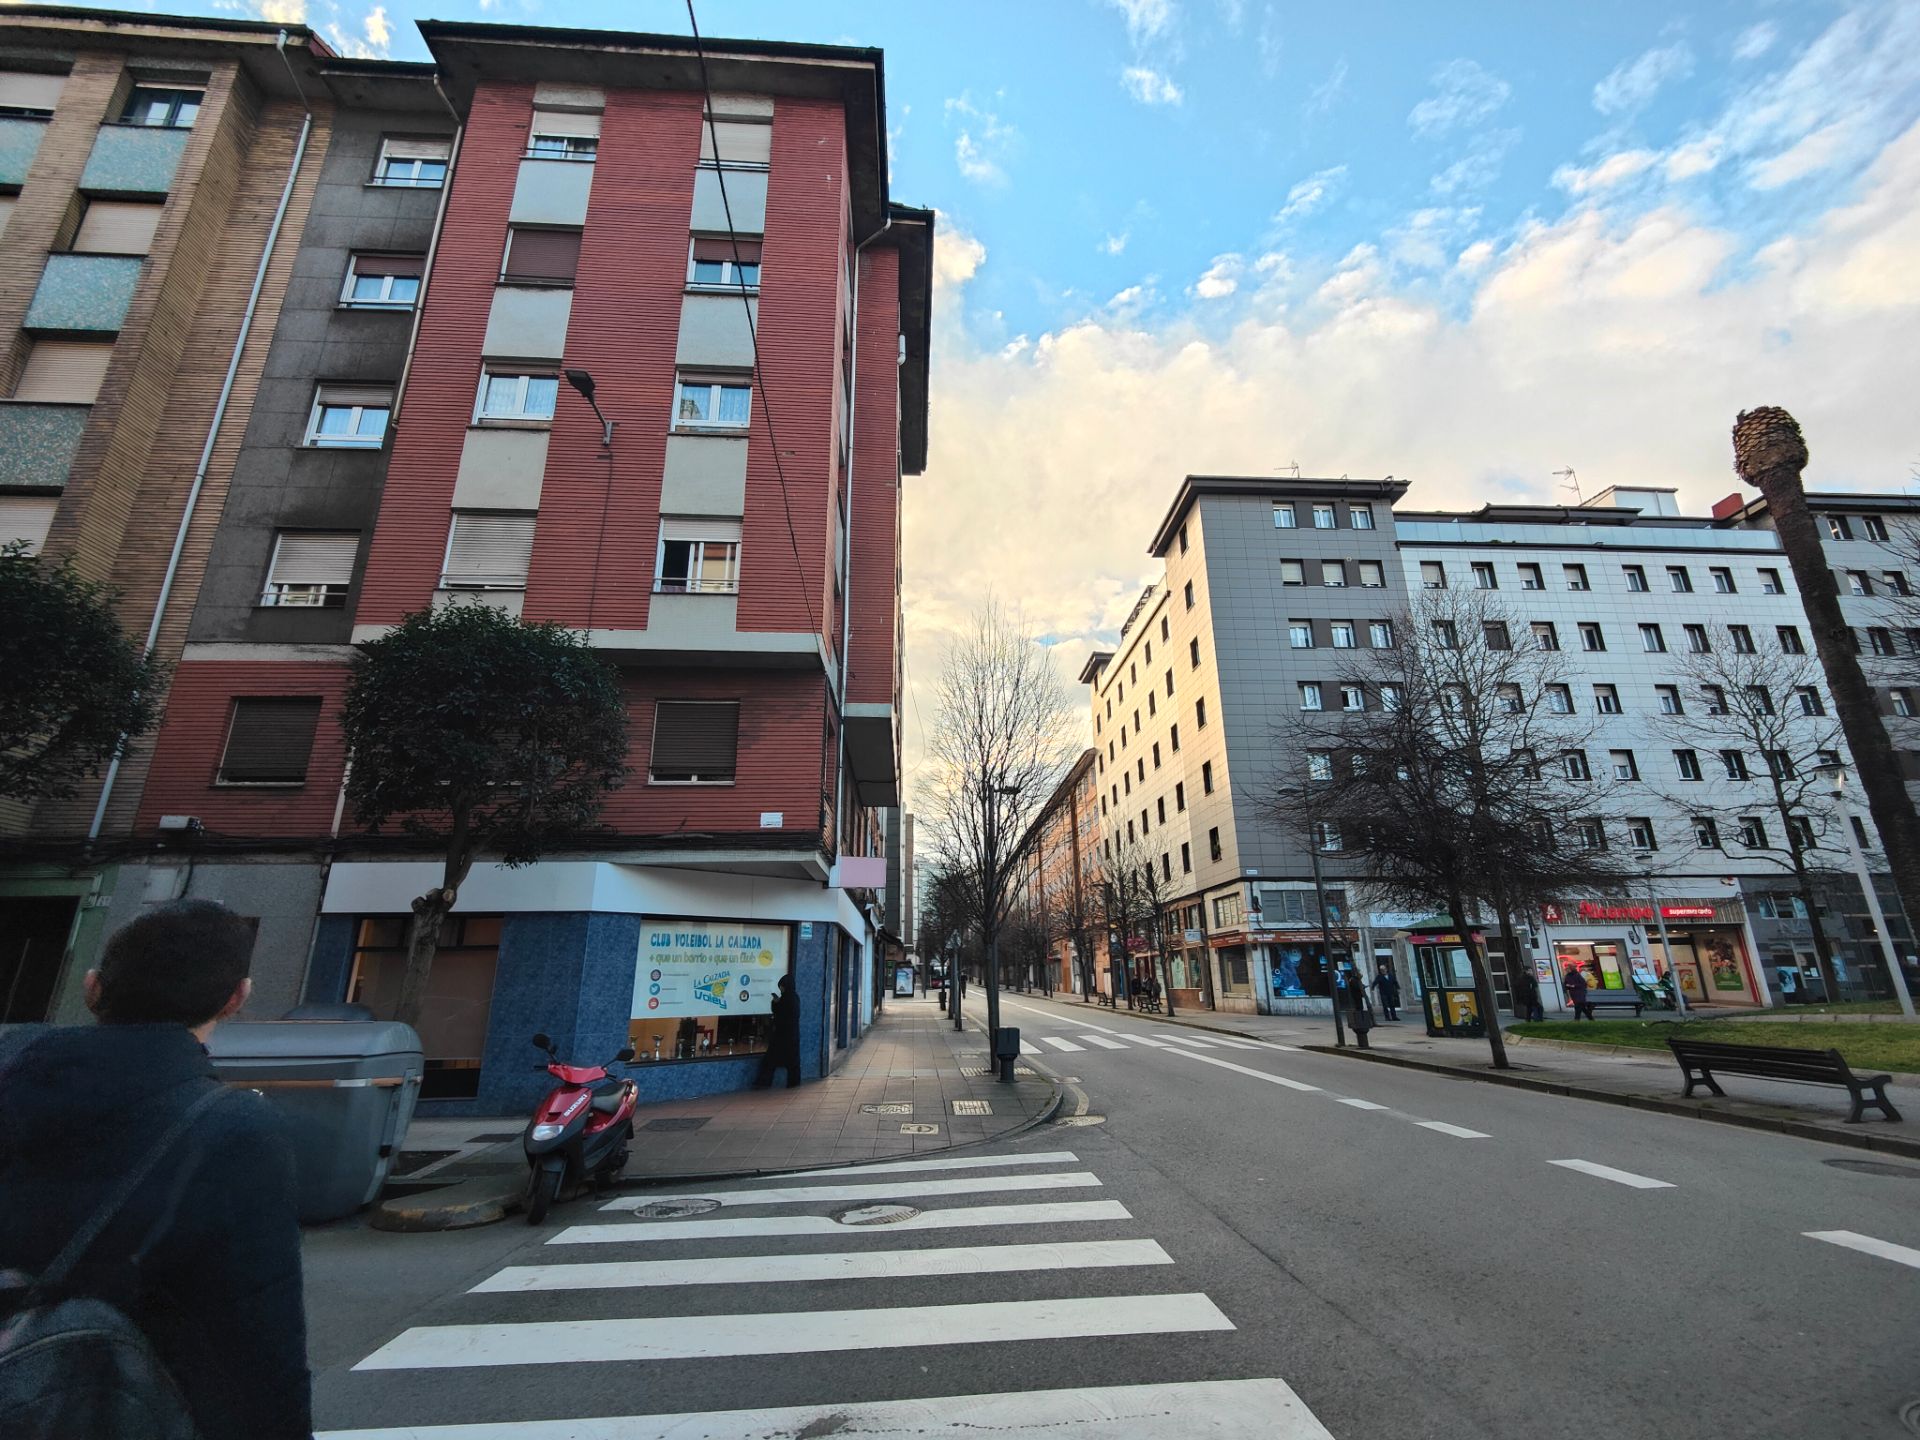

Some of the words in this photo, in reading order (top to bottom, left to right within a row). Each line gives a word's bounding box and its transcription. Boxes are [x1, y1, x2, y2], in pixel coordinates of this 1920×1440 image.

[1579, 899, 1654, 921] Alcampo
[650, 932, 671, 947] CLUB
[675, 933, 712, 948] VOLEIBOL
[715, 935, 725, 948] LA
[728, 935, 762, 949] CALZADA
[655, 953, 671, 965] que
[672, 954, 682, 963] un
[683, 952, 707, 963] barrio
[713, 954, 728, 965] que
[729, 954, 739, 963] un
[694, 990, 727, 1010] Voley
[563, 1093, 588, 1117] SUZUKI
